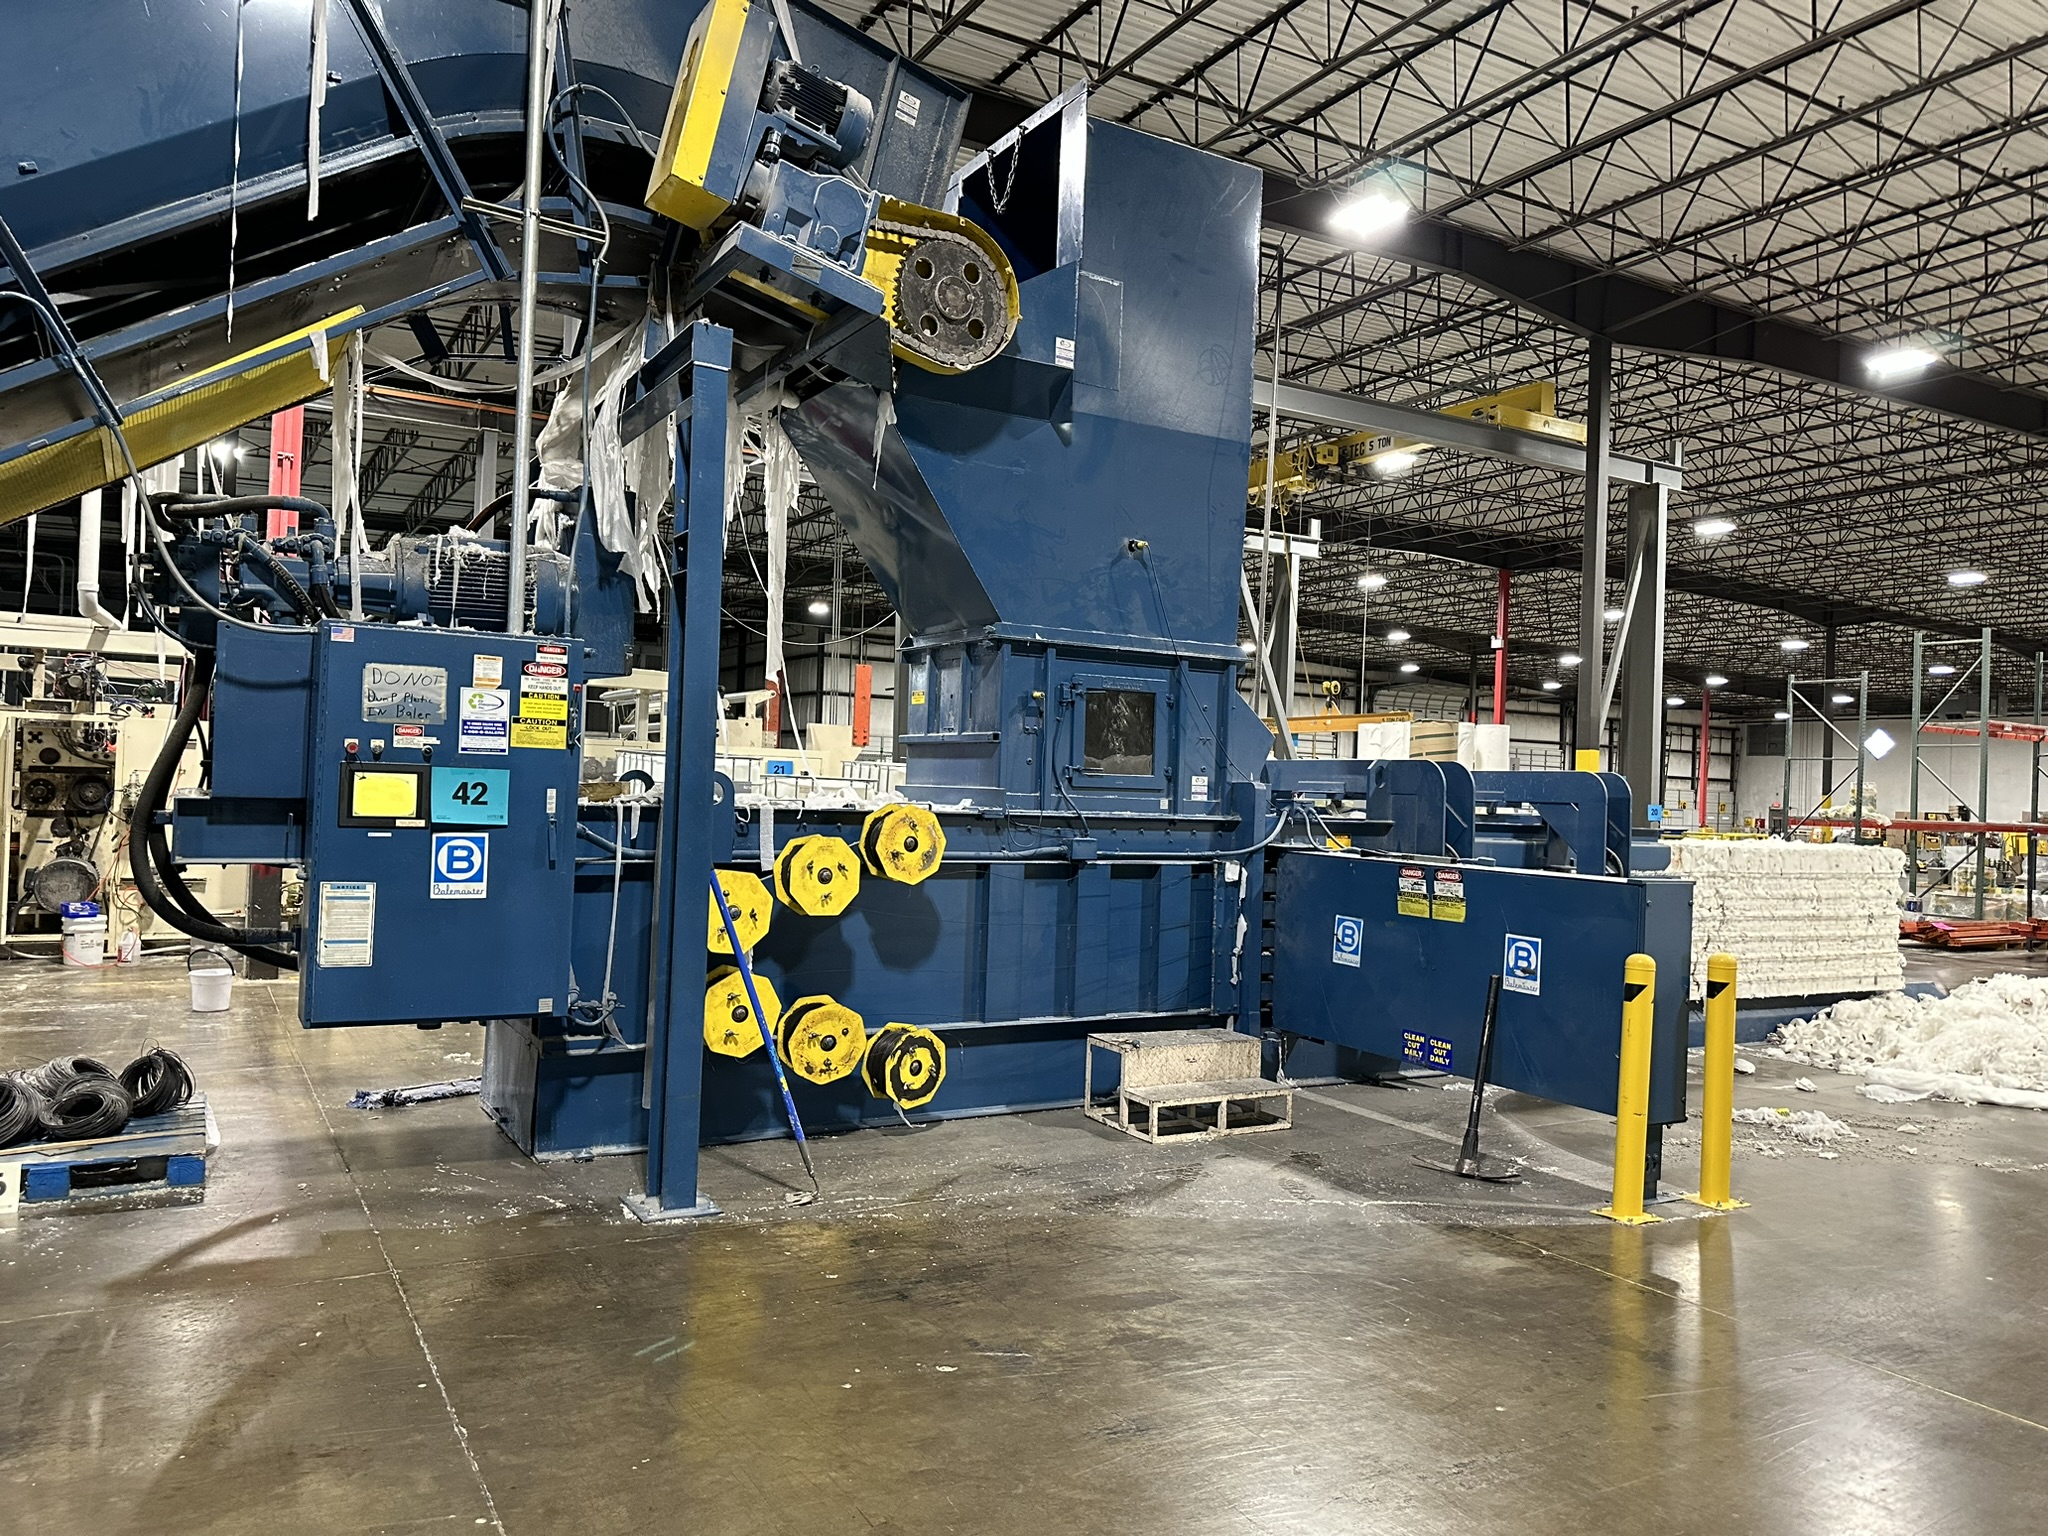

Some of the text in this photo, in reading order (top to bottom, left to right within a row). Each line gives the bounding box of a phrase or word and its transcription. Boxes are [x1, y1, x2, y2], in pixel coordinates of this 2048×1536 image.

[1377, 436, 1392, 449] TON
[528, 665, 562, 675] DANGER
[372, 667, 445, 687] DO NOT
[528, 692, 560, 700] CAUTION
[396, 704, 432, 719] Baler
[519, 717, 558, 726] CAUTION
[773, 764, 785, 775] 21
[452, 782, 488, 805] 42
[1651, 808, 1659, 816] 20
[446, 845, 474, 873] B
[1402, 869, 1422, 877] DANGER
[1437, 872, 1459, 880] DANGER
[432, 884, 484, 896] Balemaster
[1341, 925, 1356, 947] B
[1514, 945, 1532, 970] B
[1403, 1032, 1425, 1043] CLEAN
[1407, 1041, 1421, 1050] OUT
[1430, 1039, 1452, 1050] CLEAN
[1404, 1048, 1423, 1058] DAILY
[1433, 1048, 1447, 1057] OUT
[1430, 1054, 1450, 1065] DAILY
